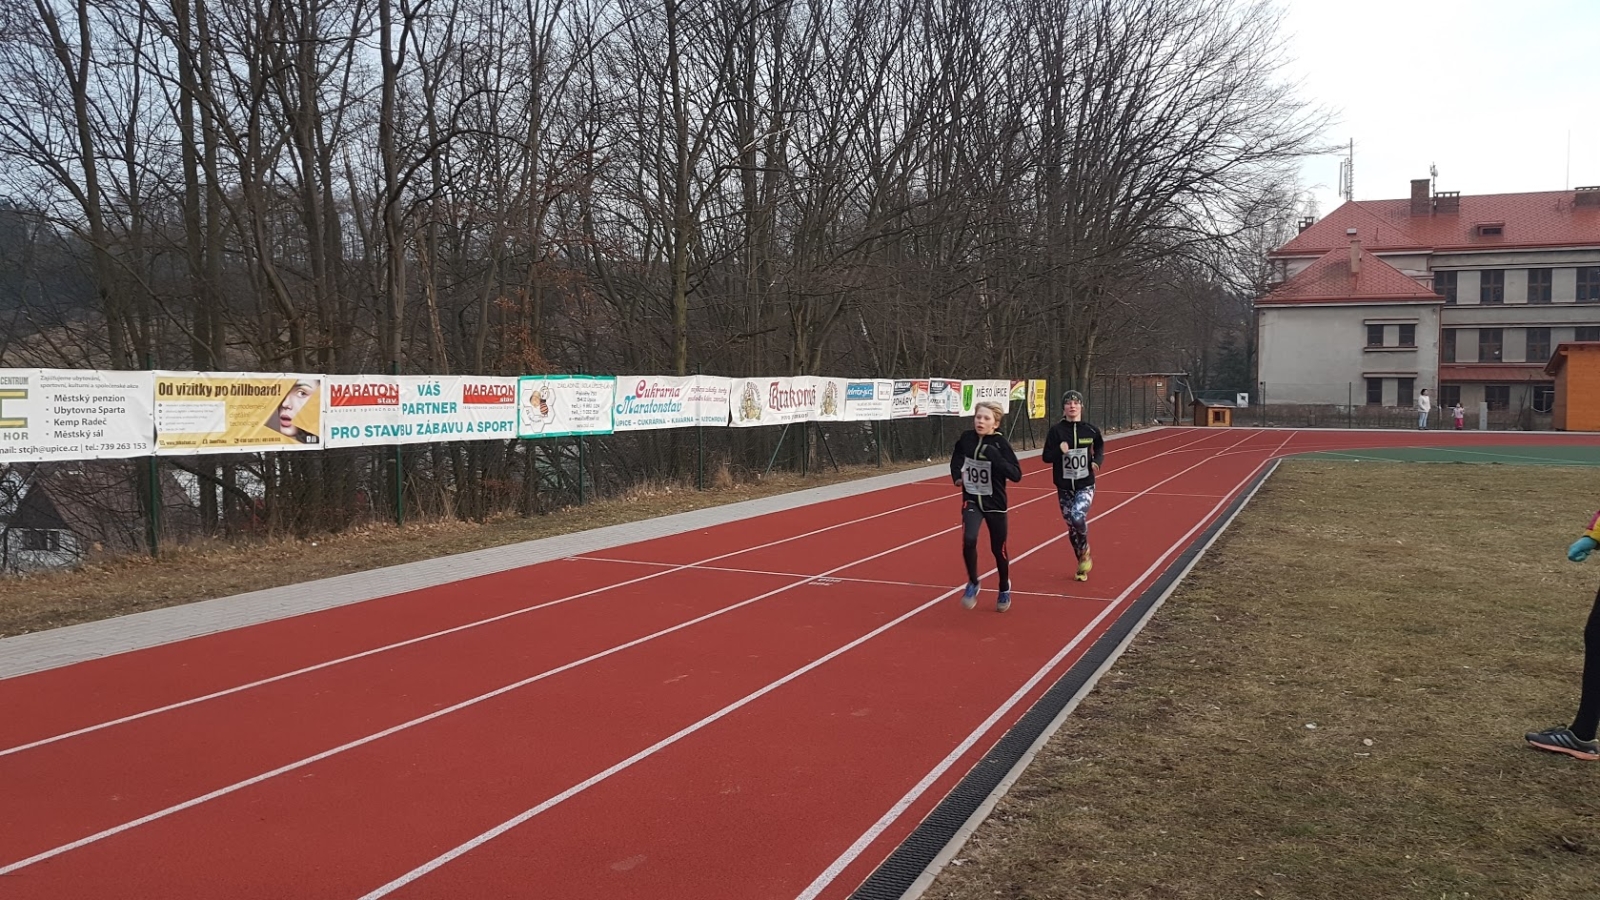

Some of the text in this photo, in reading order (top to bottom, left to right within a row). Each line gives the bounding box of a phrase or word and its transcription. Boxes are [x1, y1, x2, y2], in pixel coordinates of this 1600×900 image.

[0, 376, 28, 385] CENTRUM
[158, 382, 281, 398] Od vizitky po billboard!
[330, 384, 399, 397] MARATON
[418, 381, 440, 396] VÁŠ
[463, 384, 515, 396] MARATON
[635, 379, 680, 398] Cukrárna
[54, 394, 125, 403] Městský penzion
[616, 396, 682, 414] Maratonstav
[54, 406, 125, 416] Ubytovna Sparta
[403, 402, 457, 415] PARTNER
[54, 419, 79, 428] Kemp
[331, 420, 514, 439] PRO STAVBU ZÁBAVU A SPORT
[4, 432, 29, 440] HOR
[54, 430, 90, 439] Městský
[19, 444, 78, 454] stcjh@upice.cz
[1064, 455, 1086, 470] 200
[966, 466, 989, 484] 199
